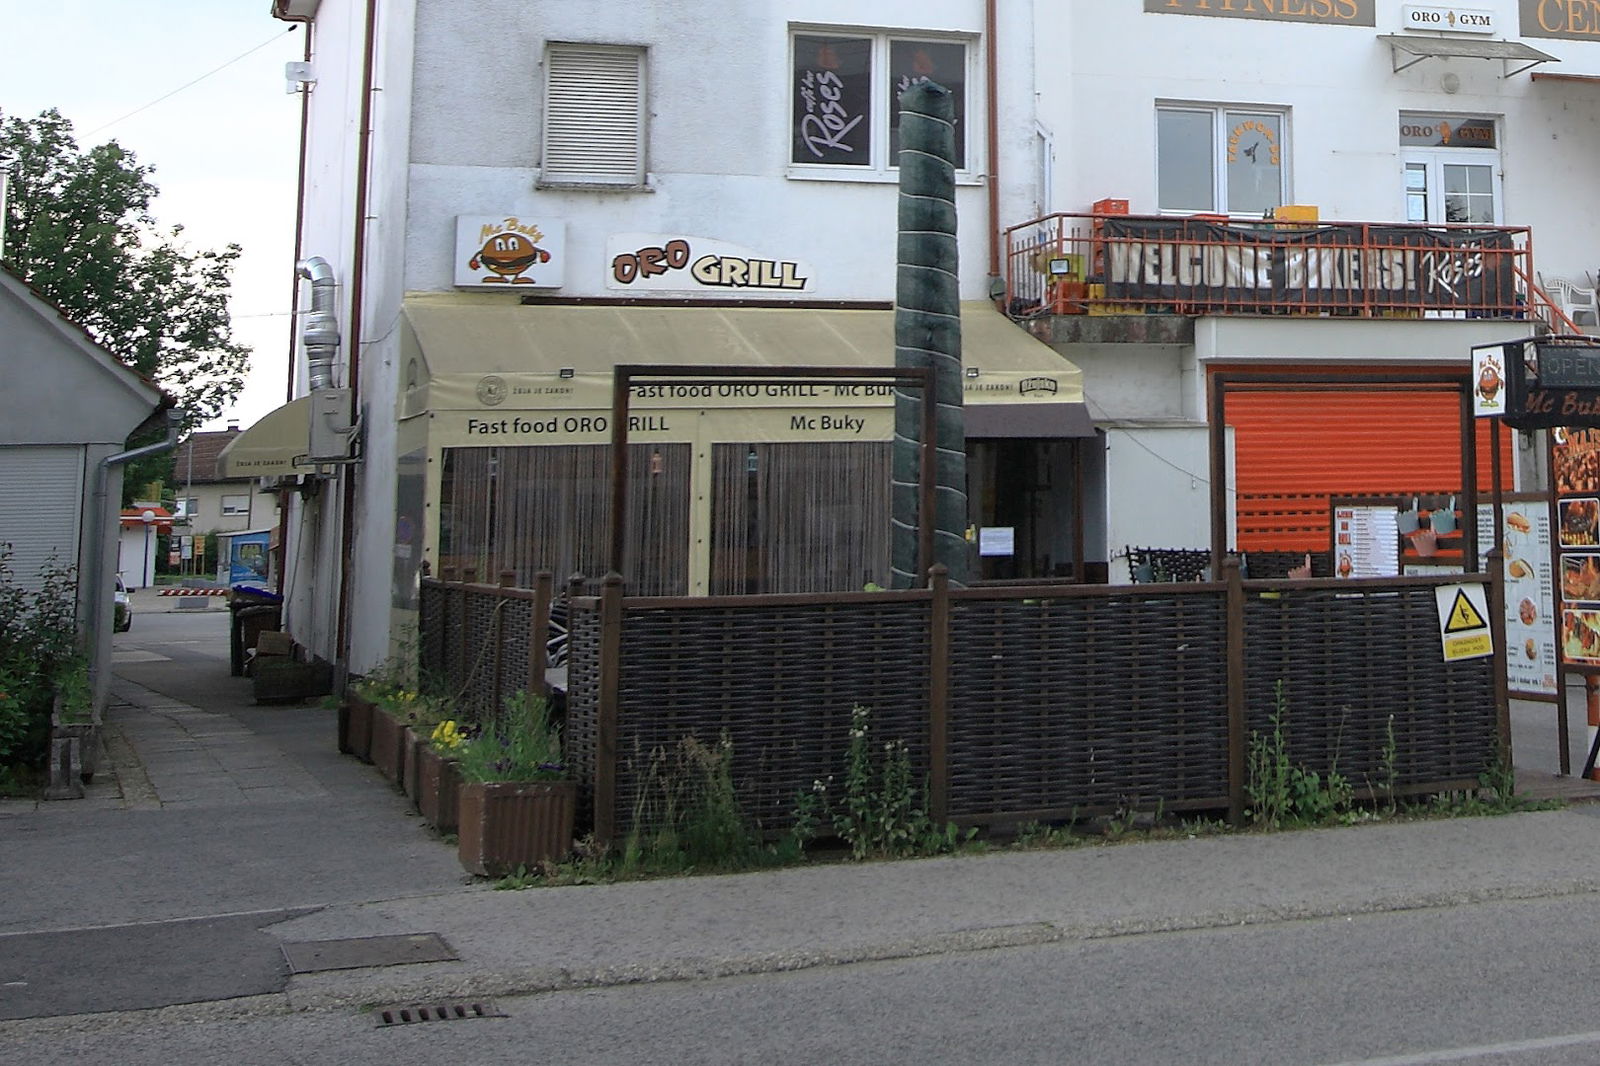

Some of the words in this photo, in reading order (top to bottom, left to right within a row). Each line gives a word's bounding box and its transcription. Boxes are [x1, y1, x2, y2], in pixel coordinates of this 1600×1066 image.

[1411, 11, 1441, 23] ORO
[1459, 14, 1491, 26] GYM
[1537, 0, 1600, 35] CE
[801, 70, 864, 157] Roses
[1401, 125, 1433, 137] ORO
[1457, 126, 1492, 140] GYM
[612, 239, 691, 285] ORO
[691, 254, 808, 290] GRILL
[1109, 238, 1273, 288] WELCOME
[629, 384, 665, 397] ast
[718, 384, 760, 397] ORO
[765, 384, 819, 397] GRILL
[1525, 390, 1554, 414] Mc
[468, 418, 508, 435] Fast
[513, 417, 558, 434] food
[564, 417, 608, 433] ORO
[628, 416, 670, 432] RILL
[790, 415, 816, 431] Mc
[821, 414, 865, 433] Buky
